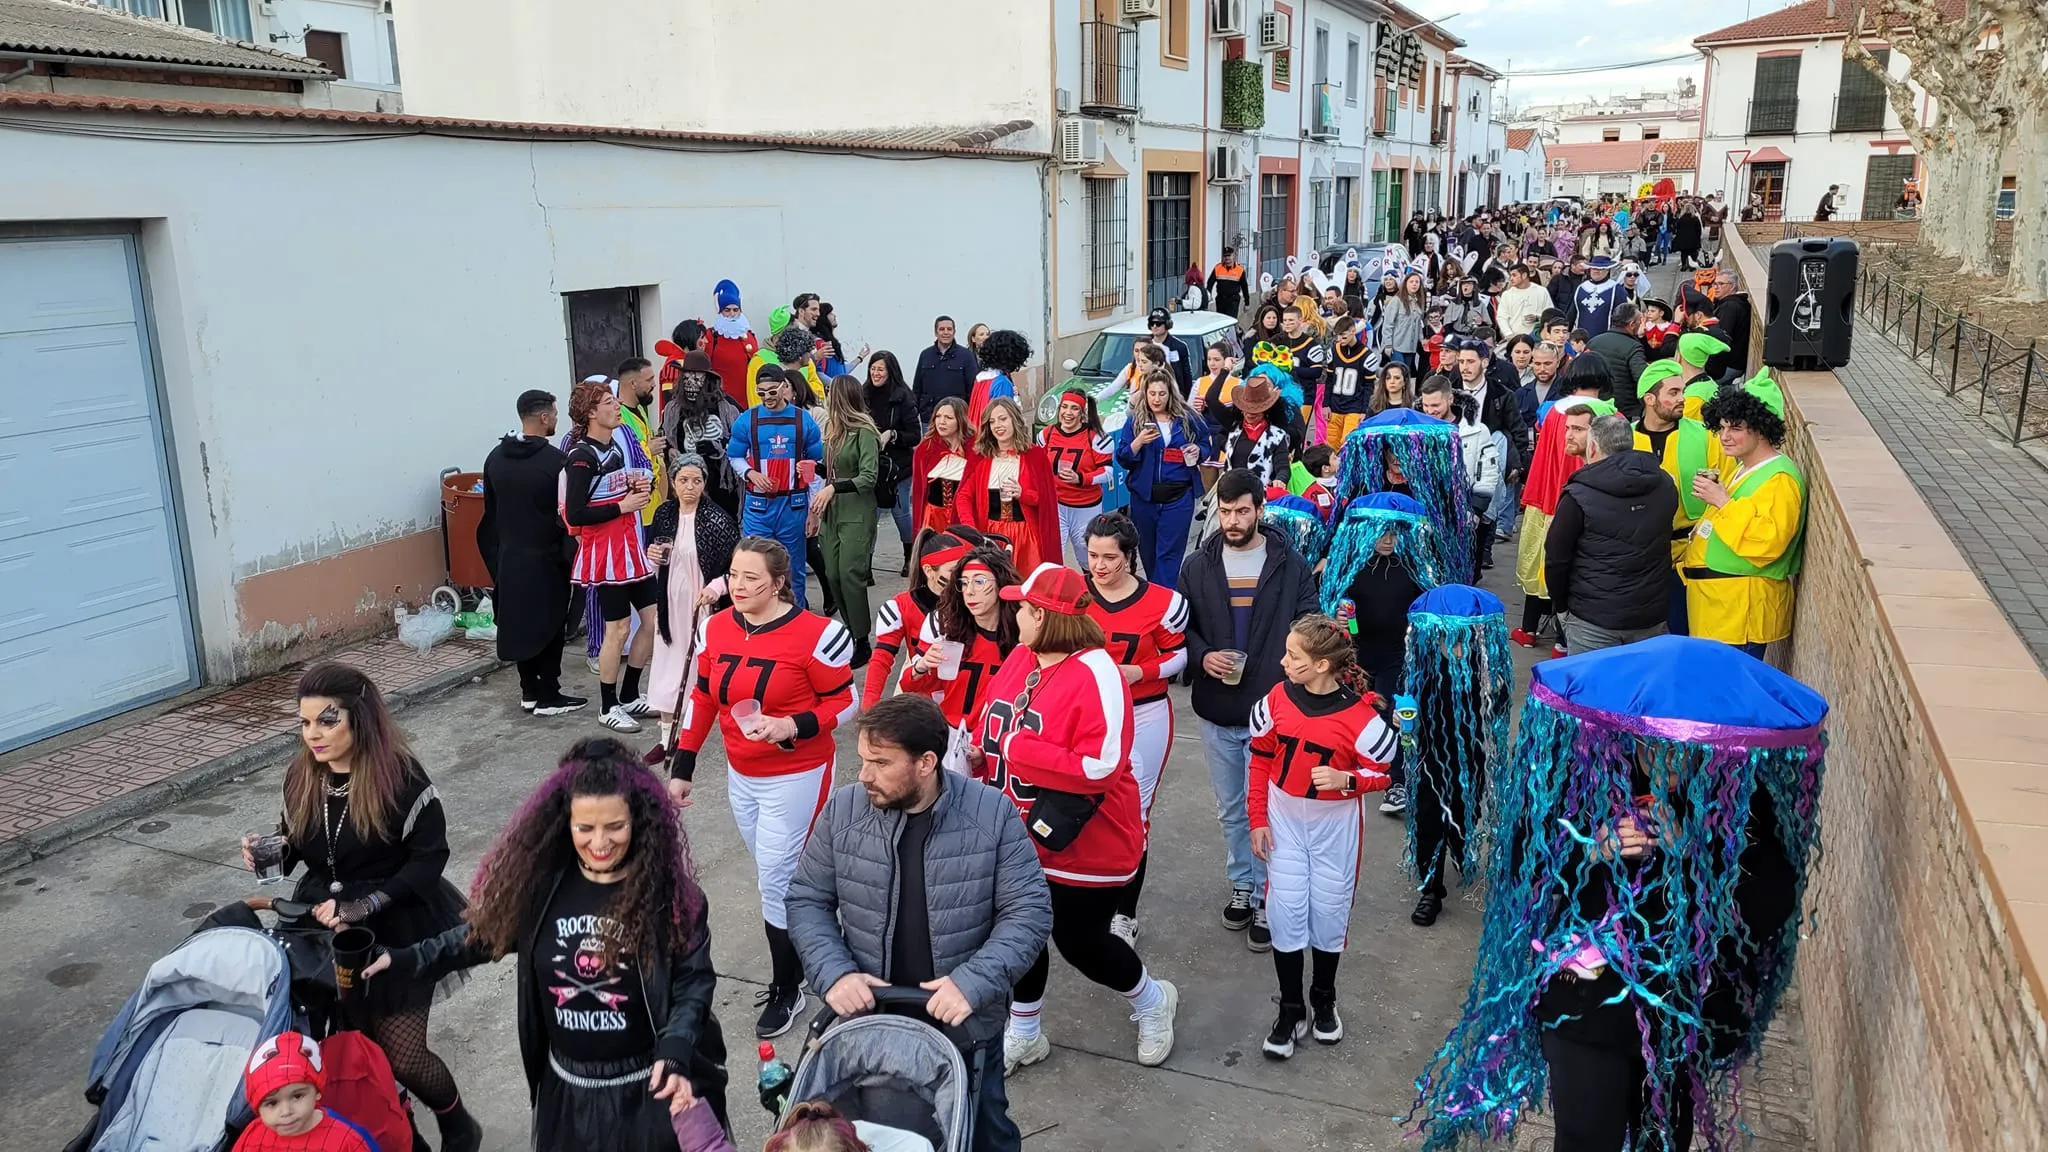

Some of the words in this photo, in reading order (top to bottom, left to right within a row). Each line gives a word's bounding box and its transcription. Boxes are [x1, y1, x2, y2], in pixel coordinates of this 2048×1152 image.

[1333, 366, 1358, 396] 10
[1050, 446, 1084, 476] 77
[717, 653, 777, 715] 77
[1276, 733, 1336, 799] 77
[556, 914, 625, 942] ROCKSTA
[555, 1006, 627, 1032] PRINCESS
